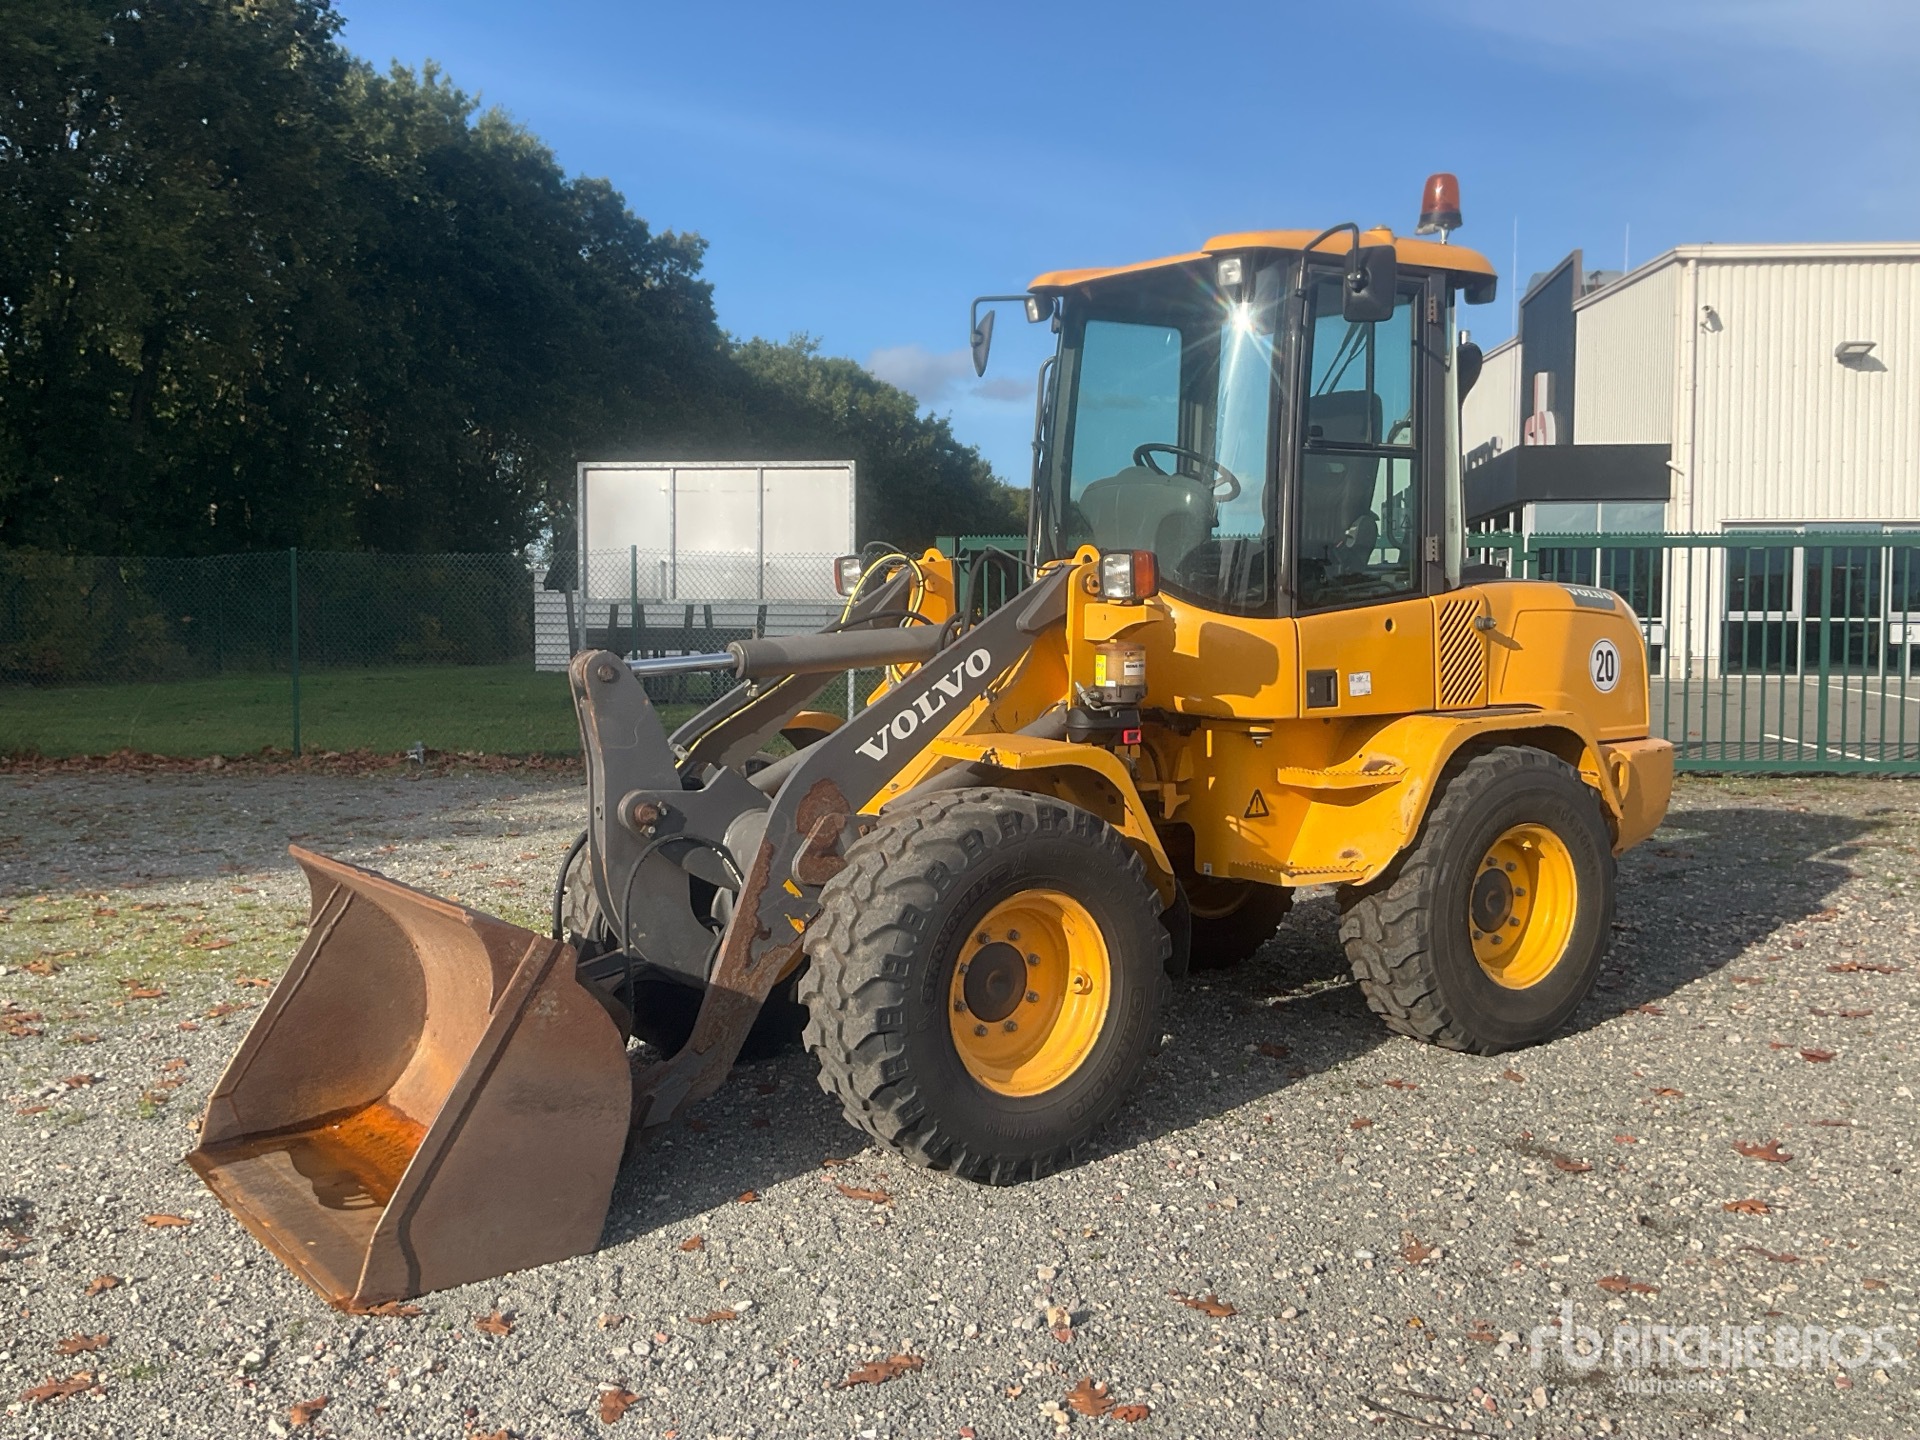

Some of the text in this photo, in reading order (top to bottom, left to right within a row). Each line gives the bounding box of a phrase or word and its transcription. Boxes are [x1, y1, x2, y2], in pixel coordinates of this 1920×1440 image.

[1563, 587, 1614, 601] VOLVO
[1596, 649, 1615, 682] 20
[855, 648, 991, 761] VOLVO
